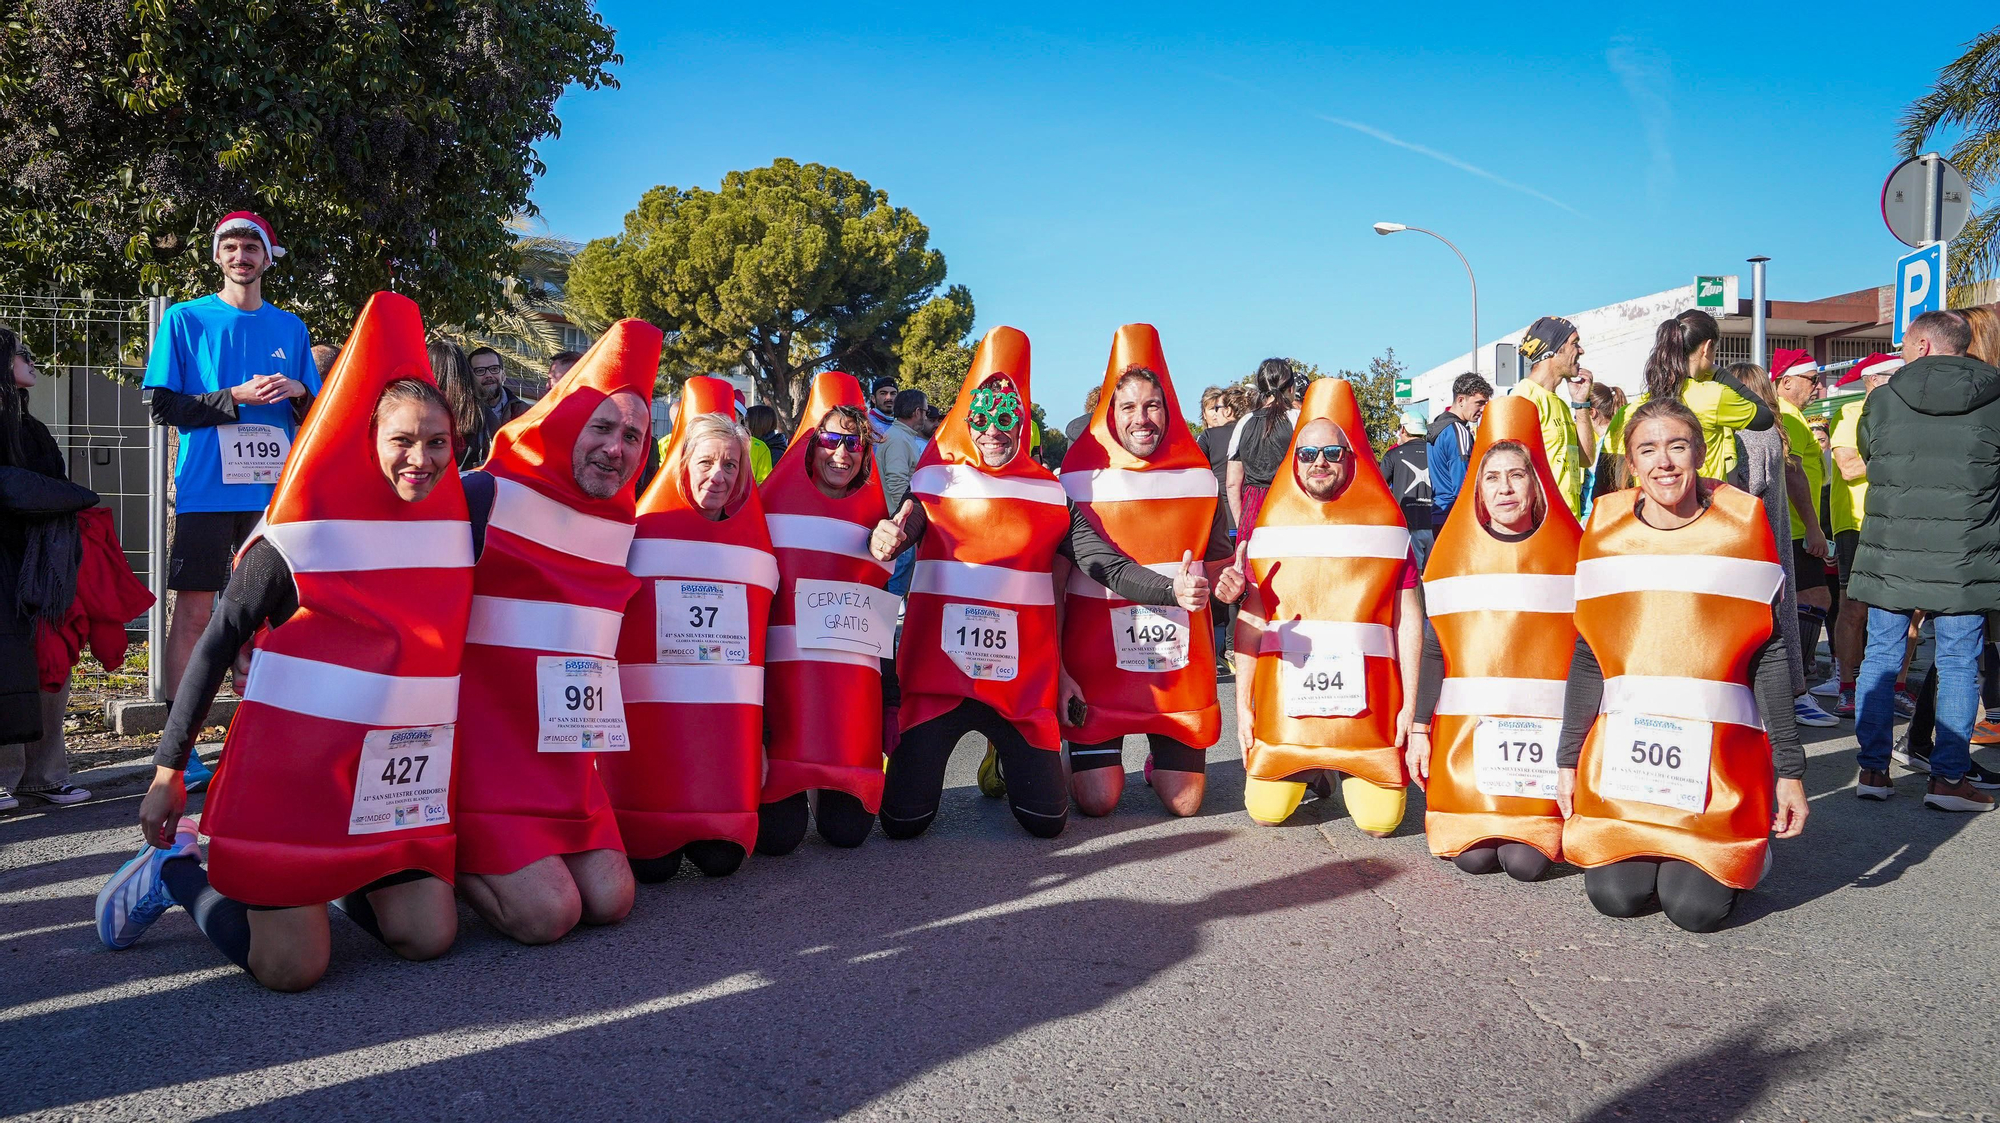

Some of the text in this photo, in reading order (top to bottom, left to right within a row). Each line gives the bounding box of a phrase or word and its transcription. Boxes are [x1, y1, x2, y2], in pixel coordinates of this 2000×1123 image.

[1902, 259, 1930, 333] P
[234, 442, 280, 457] 1199
[807, 592, 871, 609] CERVEZA
[689, 606, 718, 628] 37
[825, 614, 869, 632] GRATIS
[957, 626, 1007, 649] 1185
[1126, 624, 1177, 643] 1492
[1303, 671, 1344, 691] 494
[565, 686, 603, 711] 981
[1499, 741, 1543, 763] 179
[1631, 740, 1681, 769] 506
[381, 755, 429, 785] 427
[384, 791, 413, 799] SILVESTRE
[414, 788, 447, 796] CORDOBESA
[364, 813, 391, 822] IMDECO
